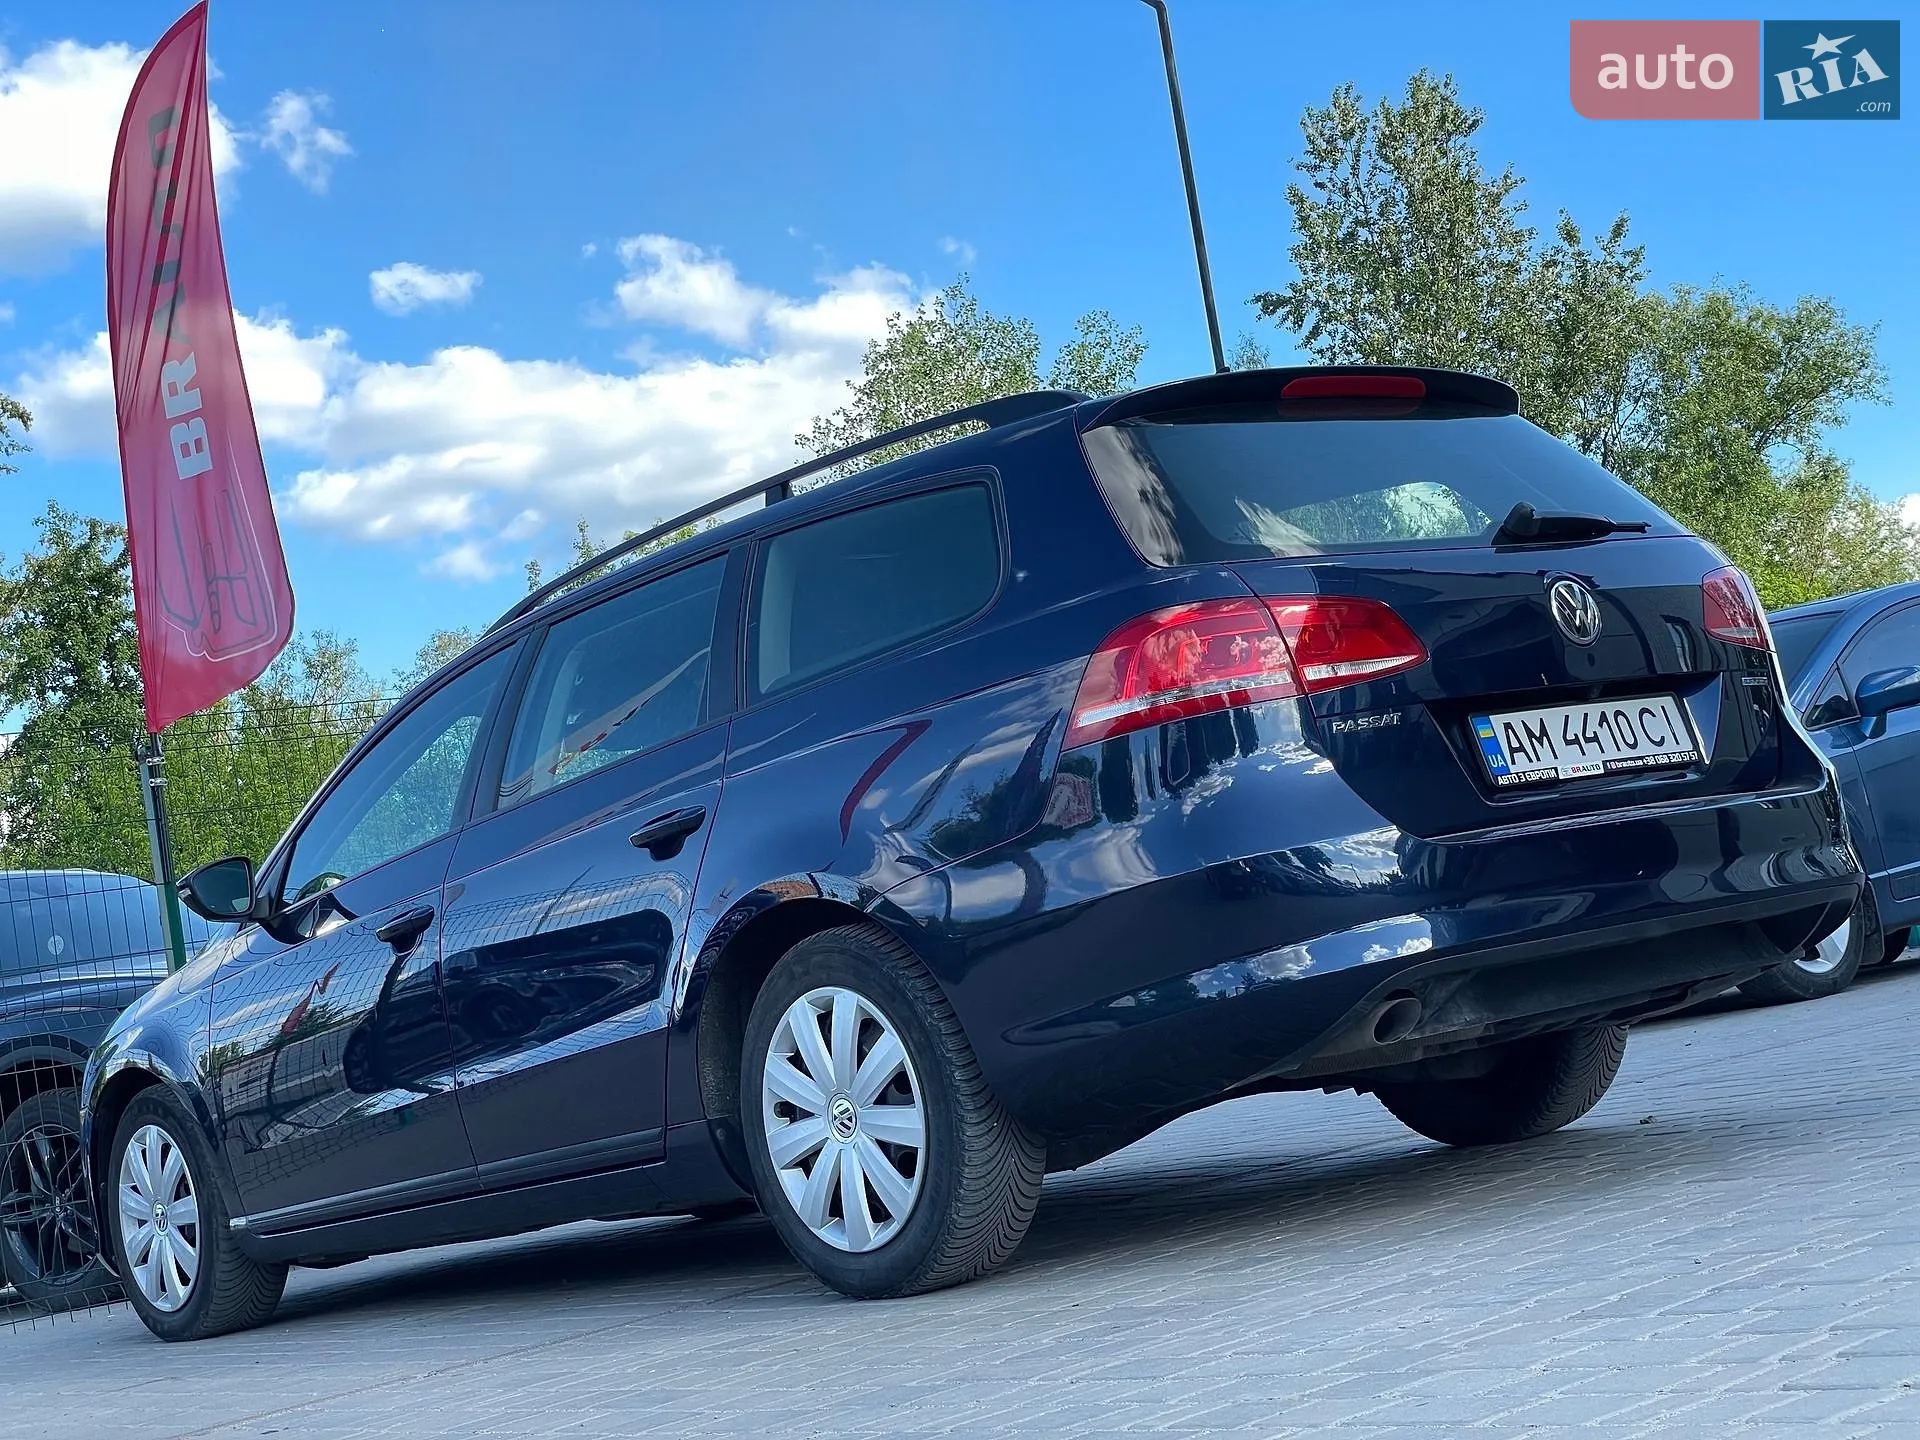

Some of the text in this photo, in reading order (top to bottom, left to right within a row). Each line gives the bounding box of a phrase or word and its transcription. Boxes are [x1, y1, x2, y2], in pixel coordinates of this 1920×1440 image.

[1332, 712, 1402, 734] PASSAT
[1502, 705, 1681, 766] AM 4410 CI
[1488, 754, 1507, 768] UA
[1571, 763, 1601, 774] BRAUTO
[1498, 773, 1518, 786] АВТО
